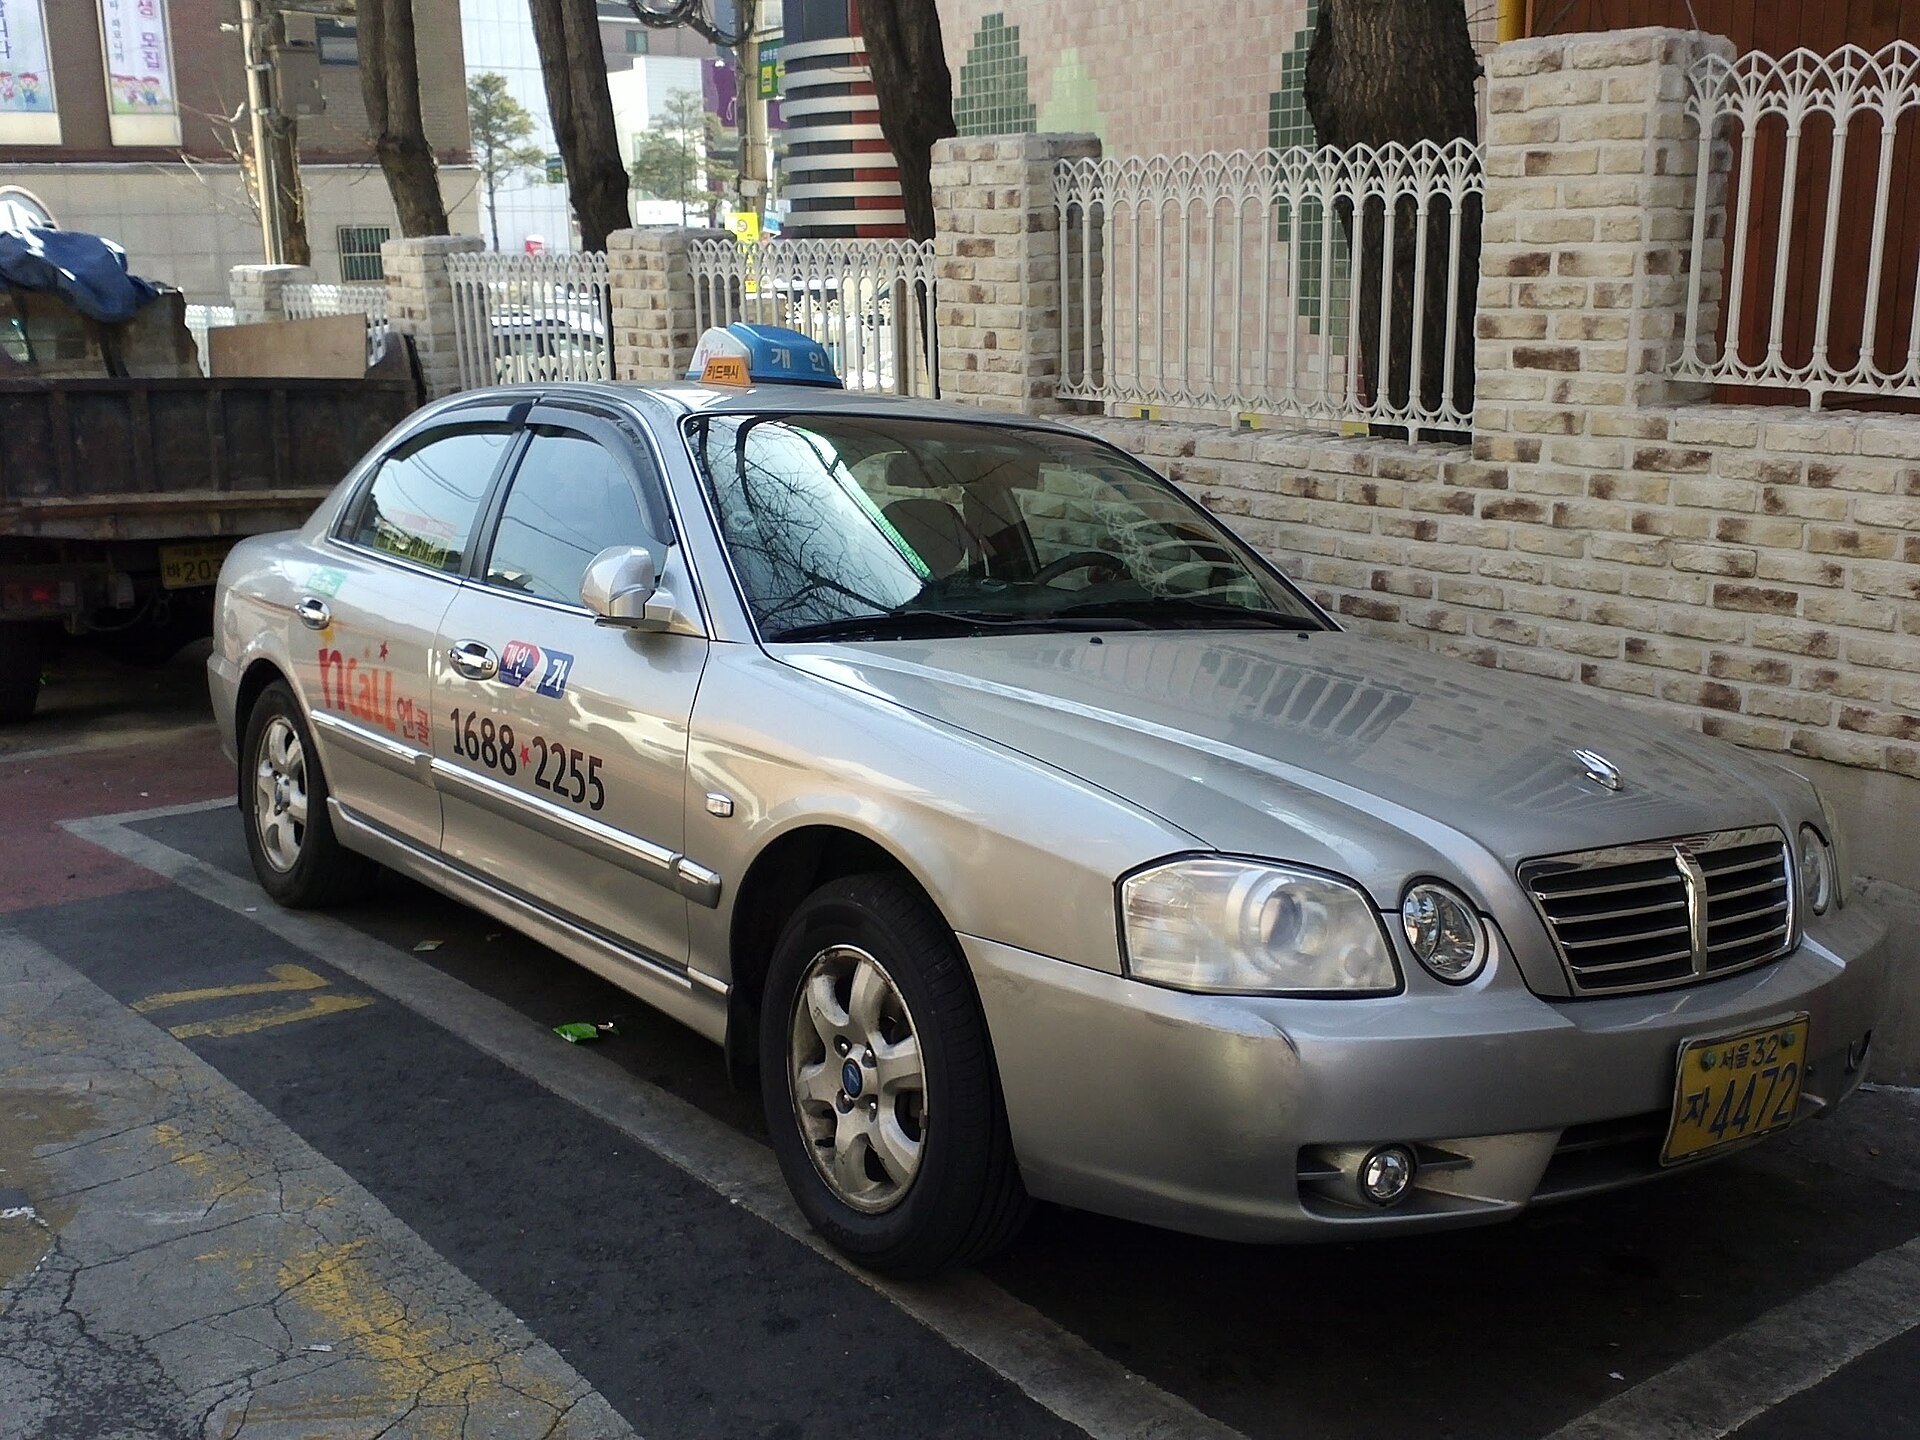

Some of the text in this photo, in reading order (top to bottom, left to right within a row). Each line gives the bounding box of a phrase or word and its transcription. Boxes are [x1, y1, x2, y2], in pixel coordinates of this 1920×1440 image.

[140, 32, 160, 68] 모집
[506, 644, 568, 692] 개인 가
